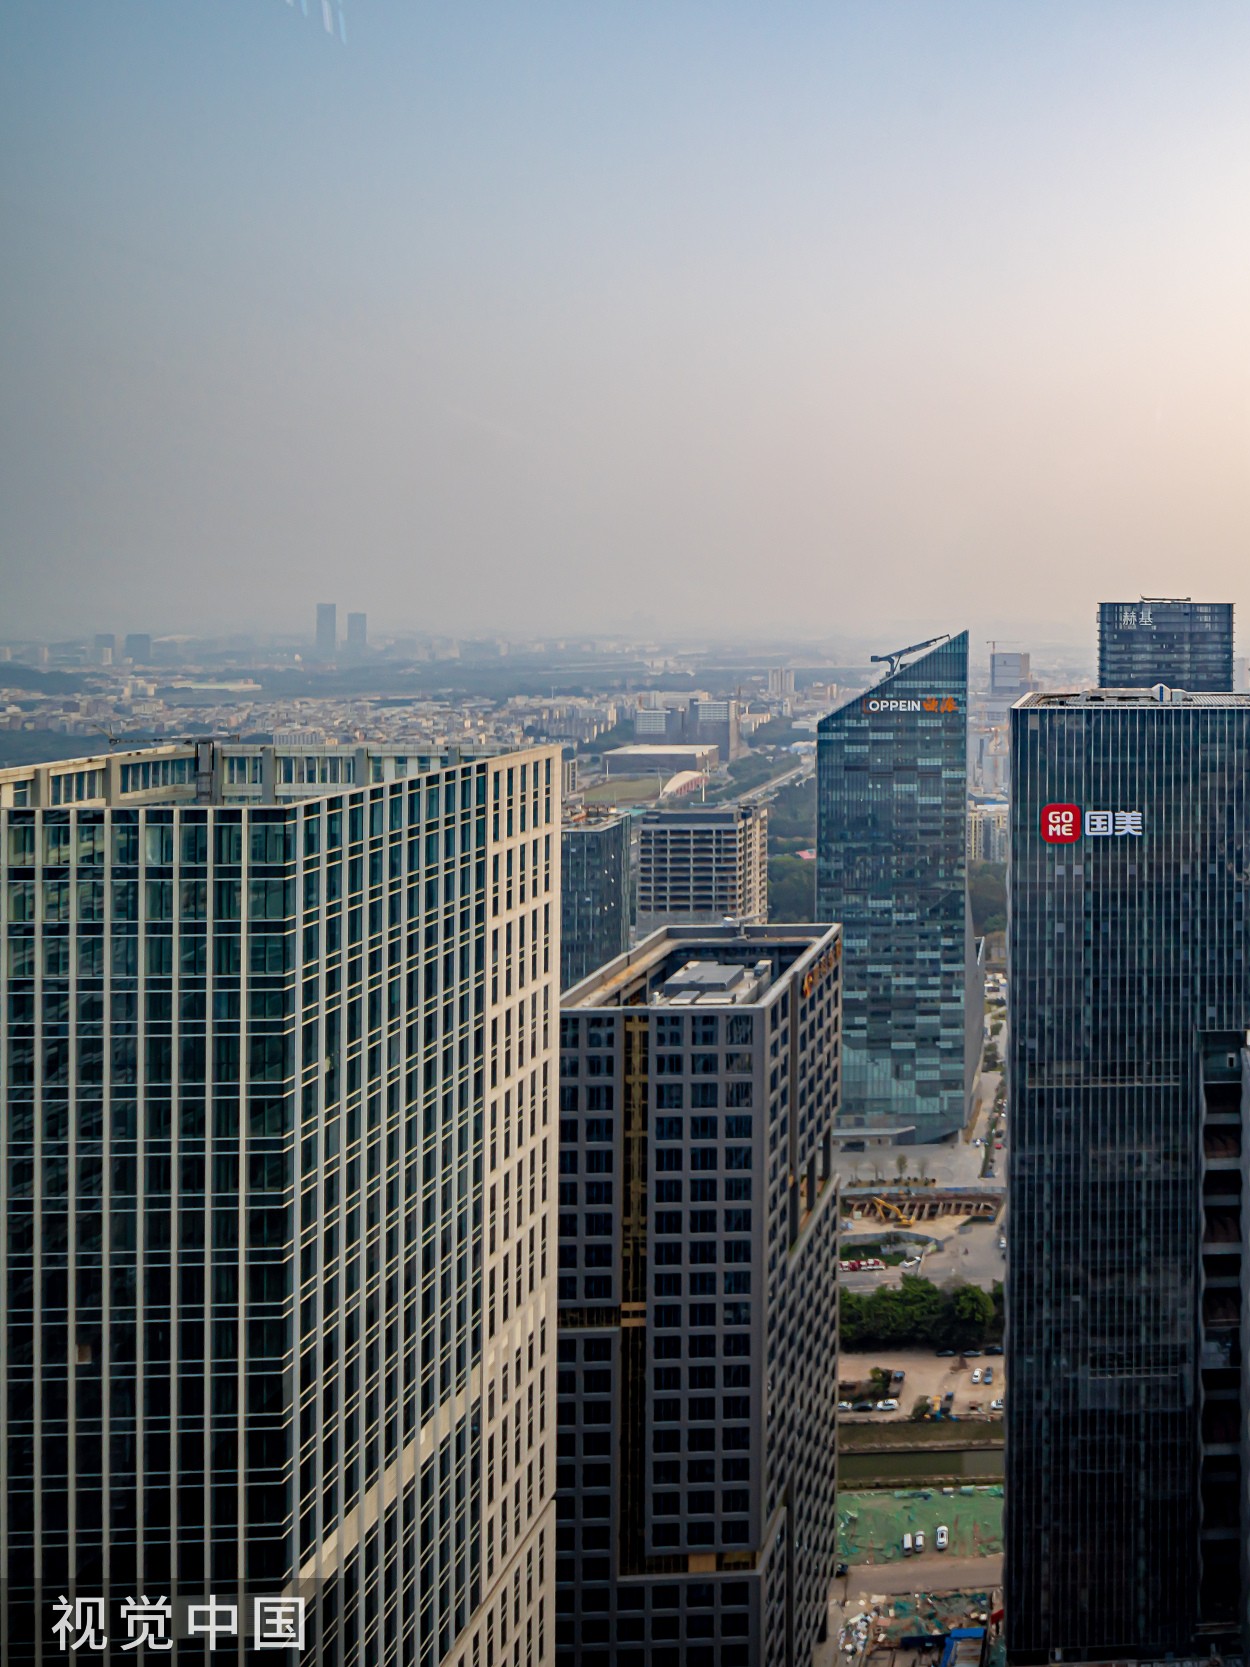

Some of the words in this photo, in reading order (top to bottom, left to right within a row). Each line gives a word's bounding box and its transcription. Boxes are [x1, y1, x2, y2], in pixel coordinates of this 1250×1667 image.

[869, 700, 921, 712] OPPEIN
[1048, 811, 1074, 824] GO
[1085, 810, 1143, 836] 国美
[1048, 824, 1073, 837] ME
